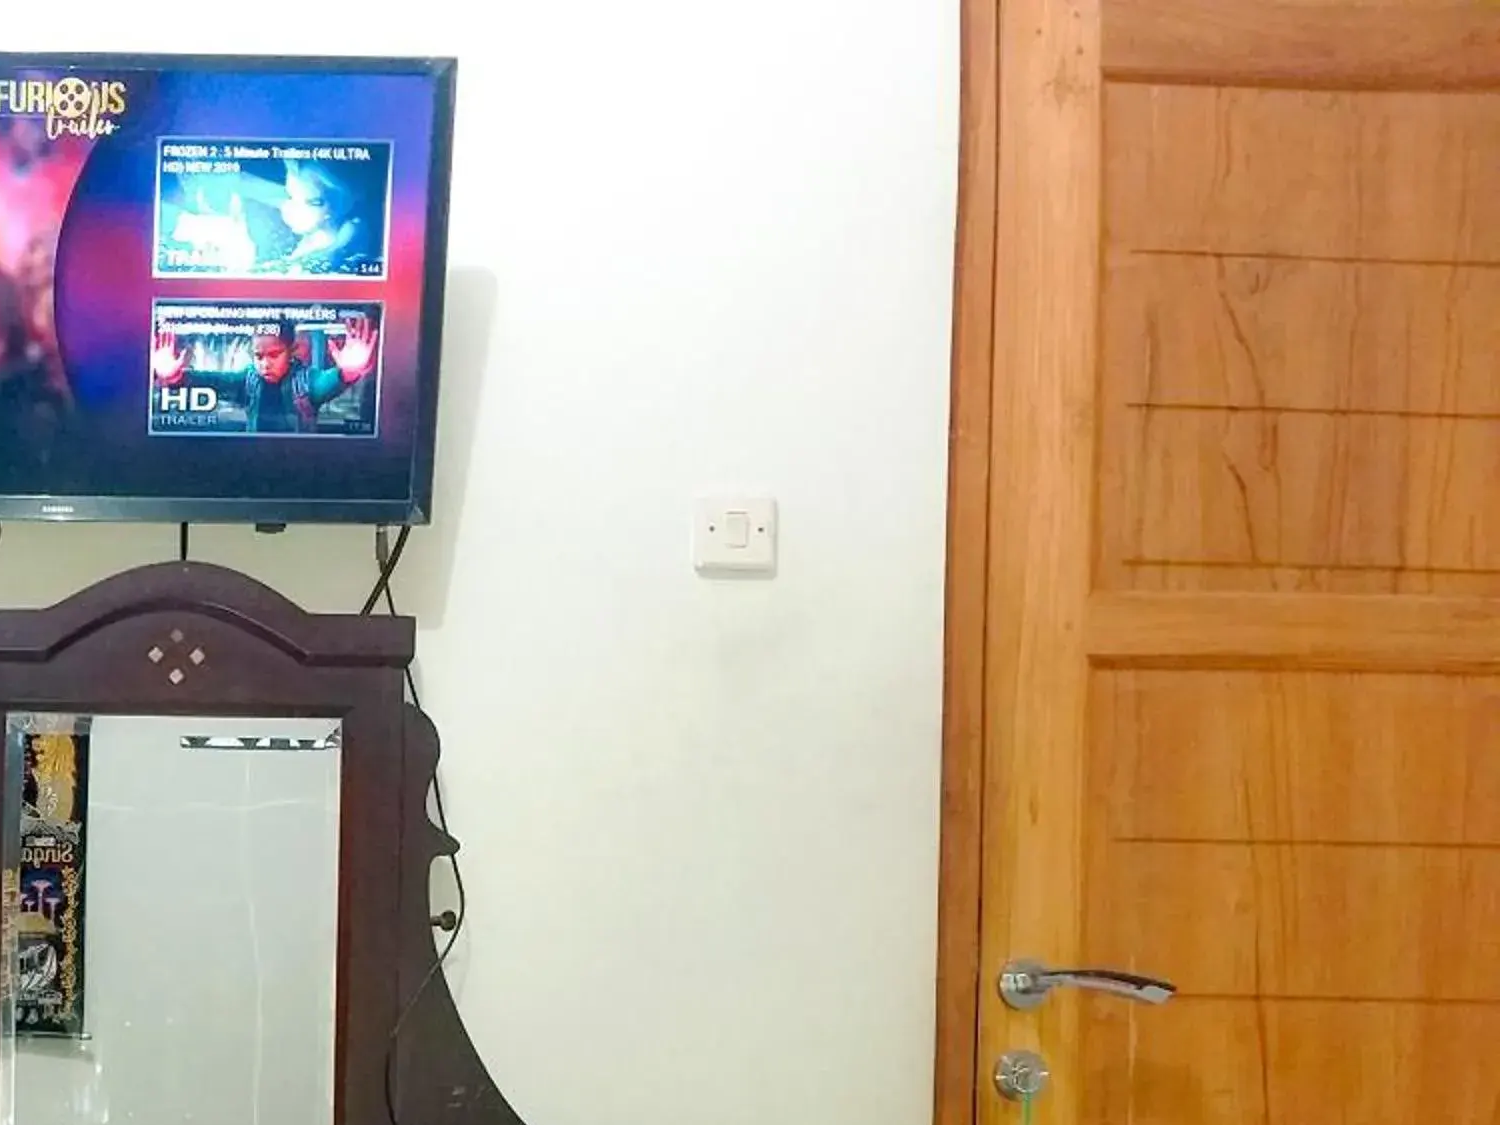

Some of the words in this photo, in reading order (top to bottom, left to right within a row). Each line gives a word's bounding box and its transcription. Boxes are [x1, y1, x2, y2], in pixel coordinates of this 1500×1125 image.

[163, 145, 207, 157] FROZEN
[333, 148, 371, 161] ULTRA
[160, 387, 217, 412] HD
[160, 414, 218, 426] TRAILER
